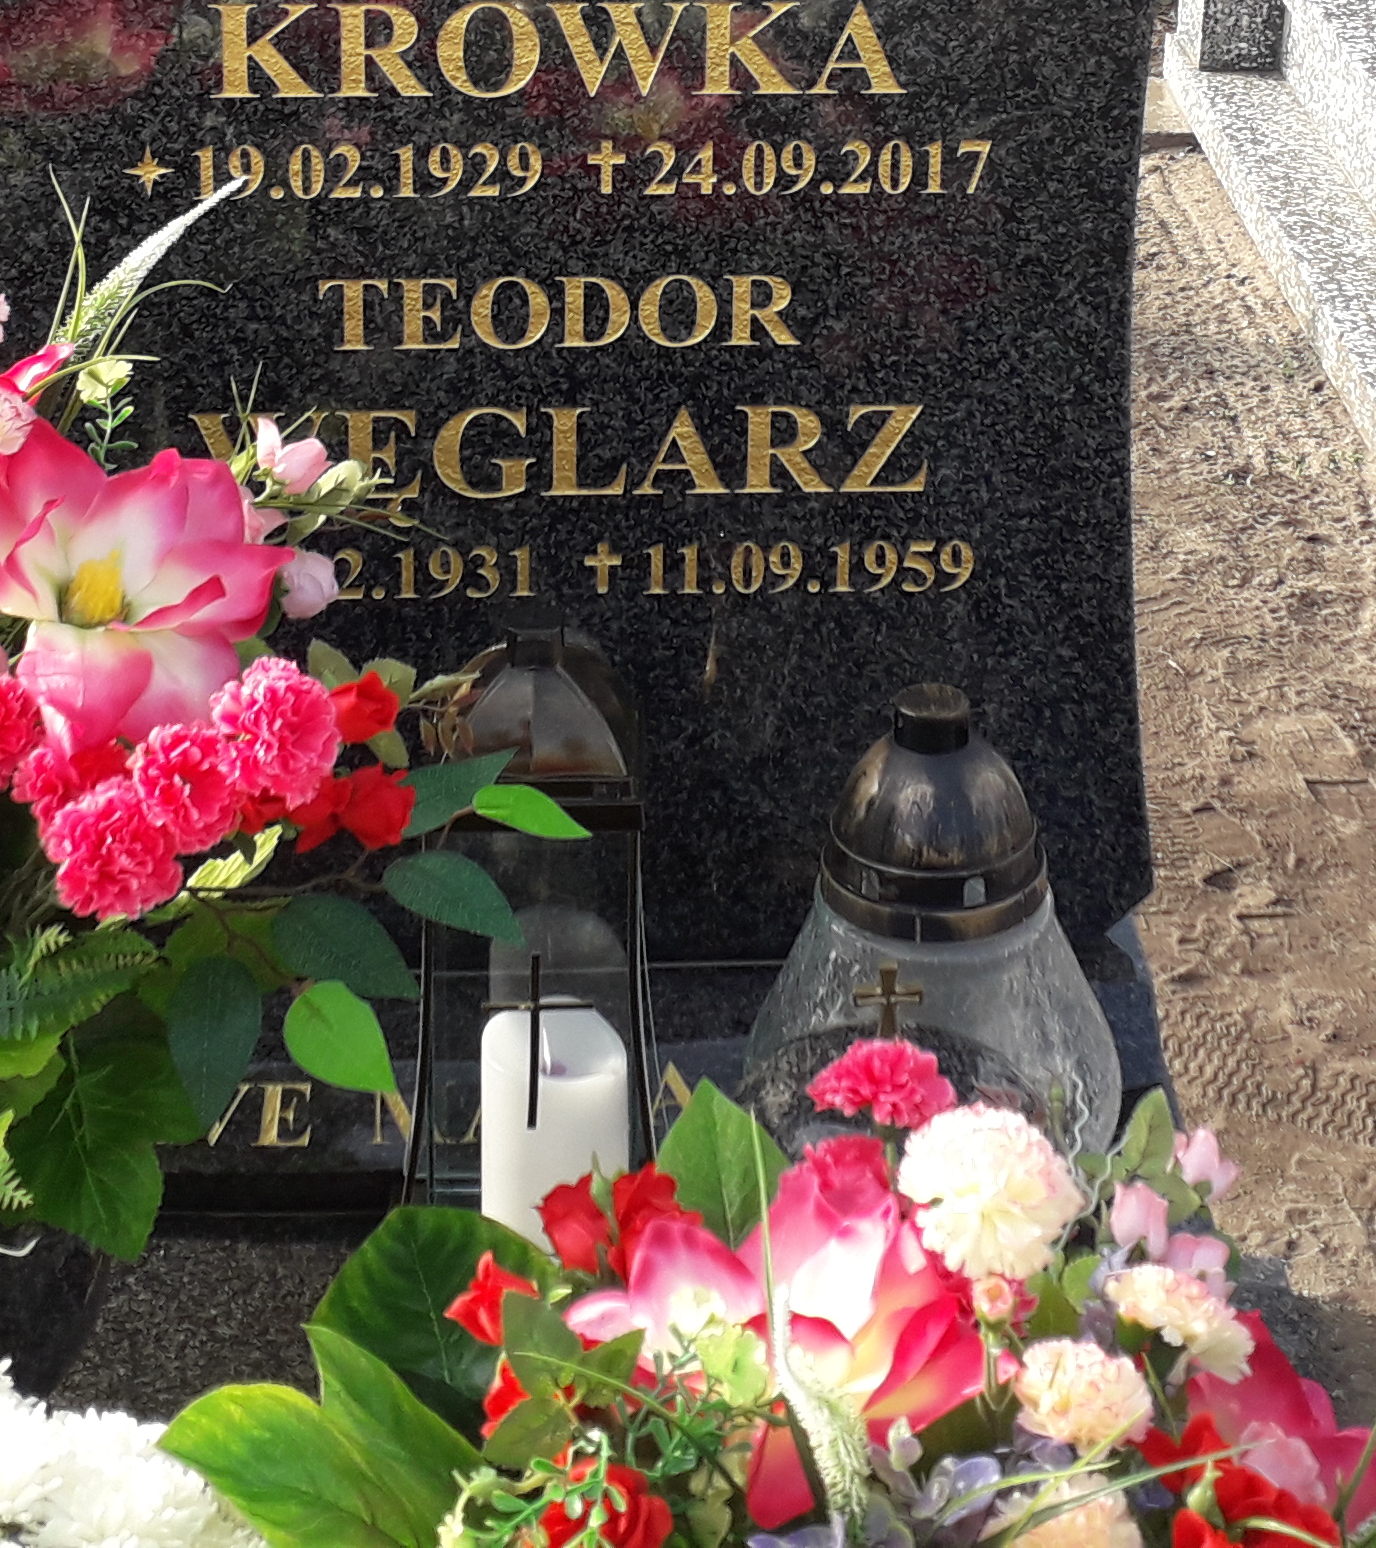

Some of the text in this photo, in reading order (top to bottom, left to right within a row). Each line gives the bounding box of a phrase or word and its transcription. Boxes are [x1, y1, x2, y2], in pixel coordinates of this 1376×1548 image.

[191, 139, 994, 202] 19.02.1929 24.09.2017
[318, 273, 801, 353] TEODOR
[643, 539, 976, 597] 11.09.1959
